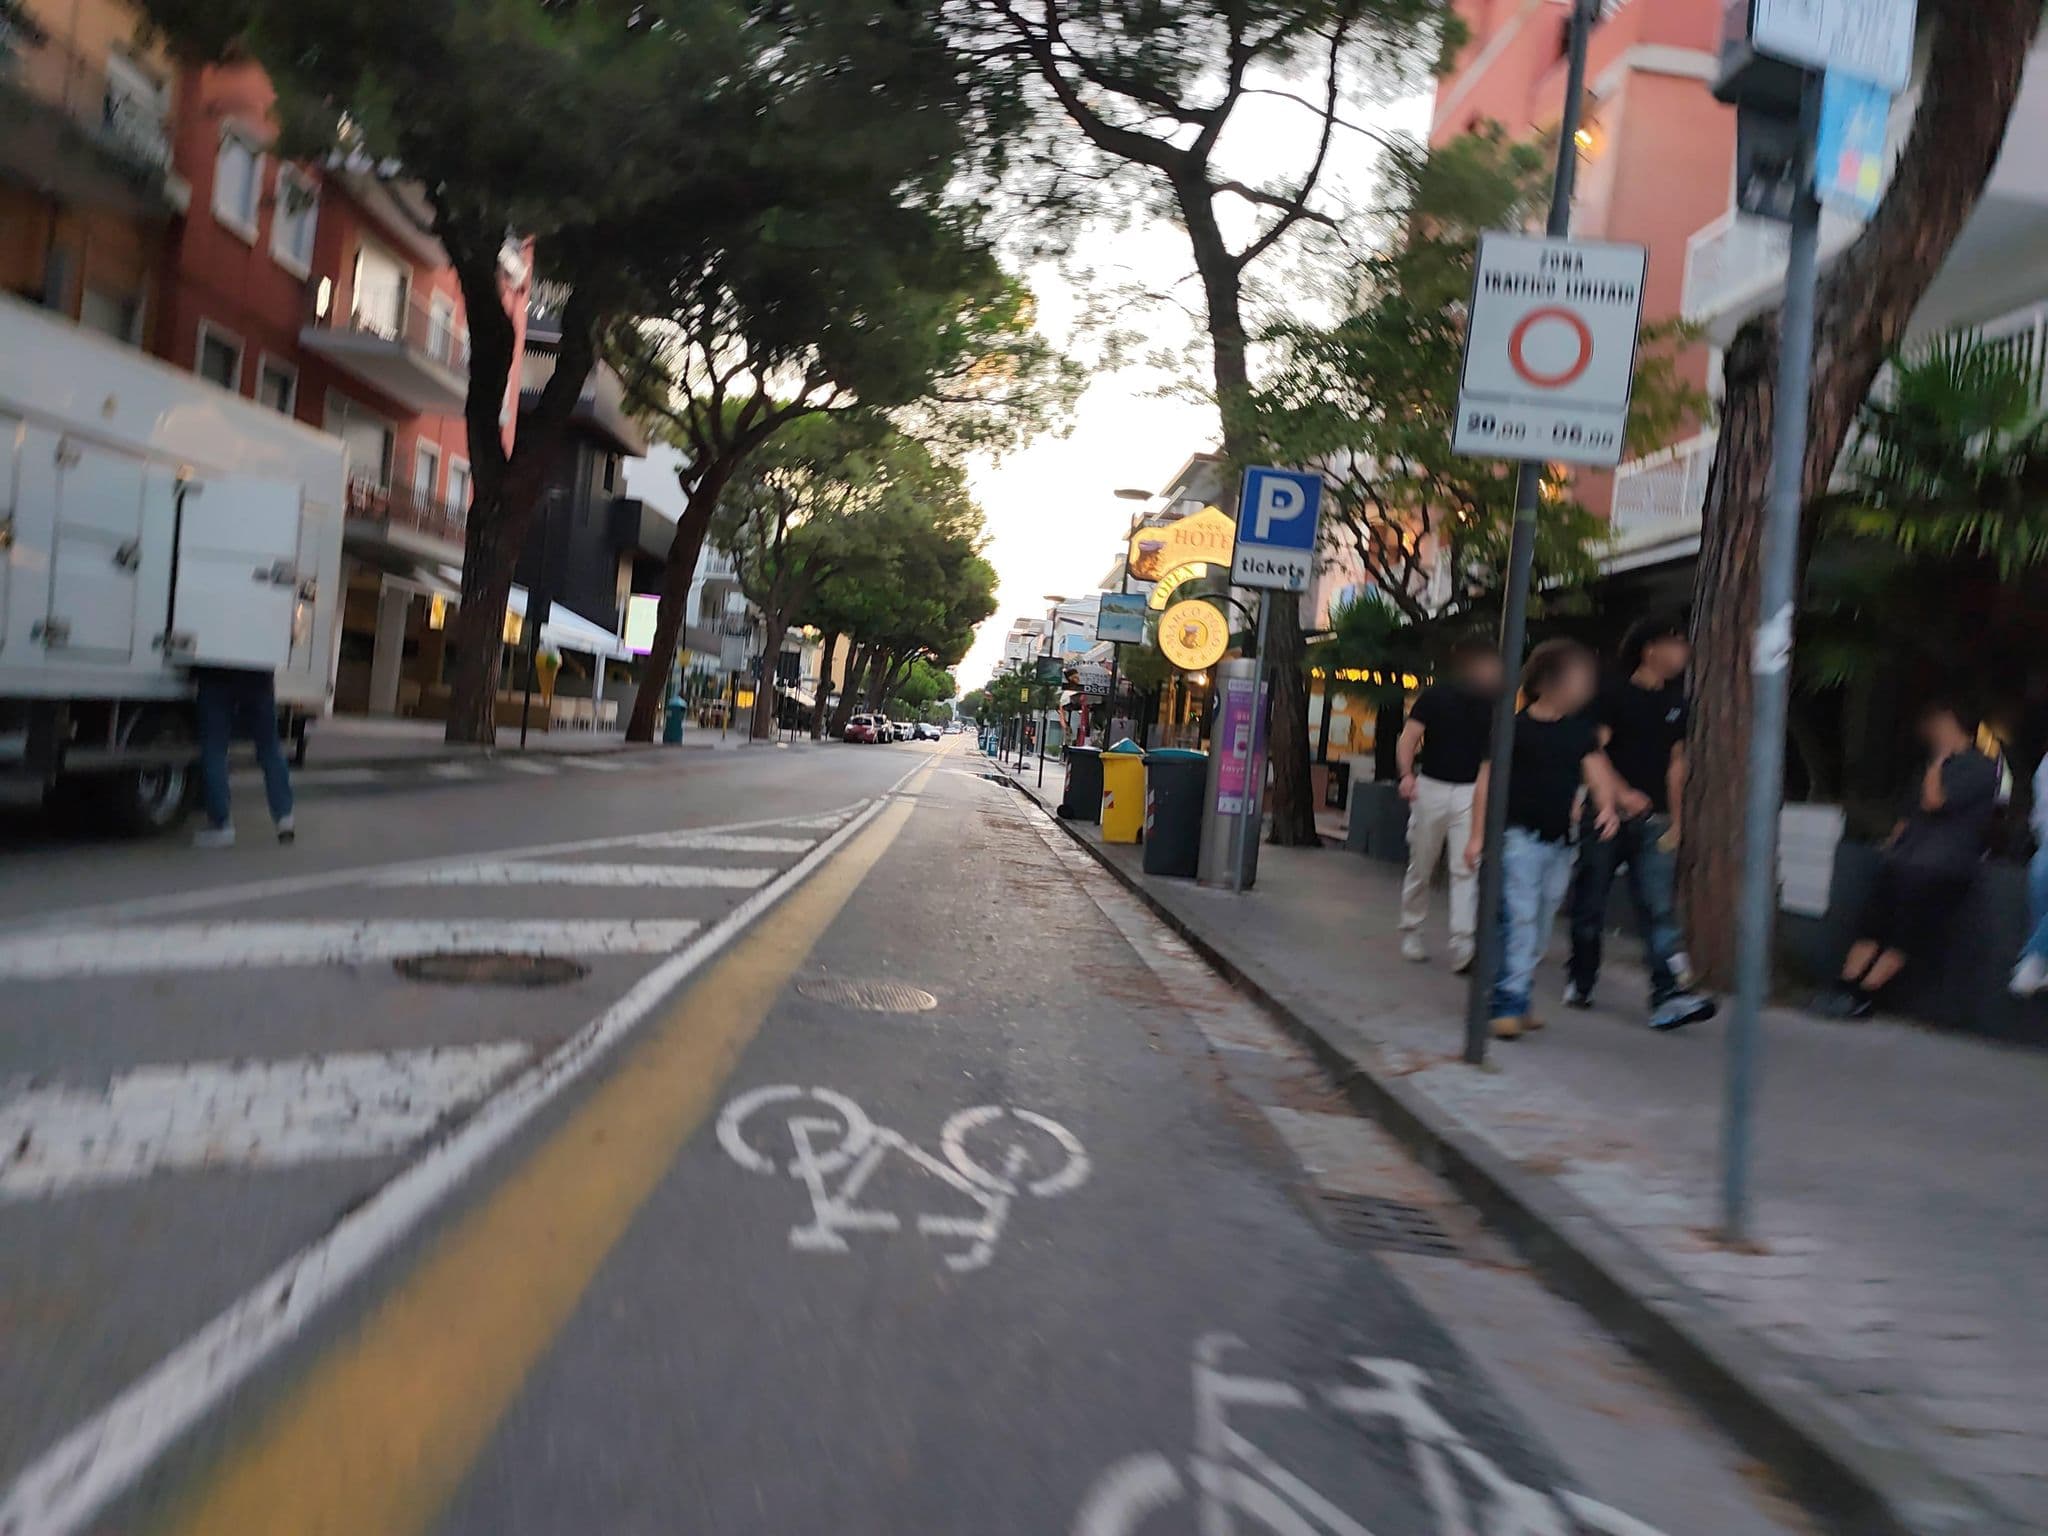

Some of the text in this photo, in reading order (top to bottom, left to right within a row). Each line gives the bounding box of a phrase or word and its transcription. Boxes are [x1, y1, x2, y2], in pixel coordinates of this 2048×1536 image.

[1537, 246, 1585, 274] ZONA
[1483, 269, 1636, 307] TRAFFICO LIMITATO
[1253, 474, 1307, 540] P
[1174, 527, 1232, 550] HOTE
[1156, 565, 1197, 599] OPEN
[1240, 556, 1307, 579] tickets
[1166, 606, 1201, 640] MARCO
